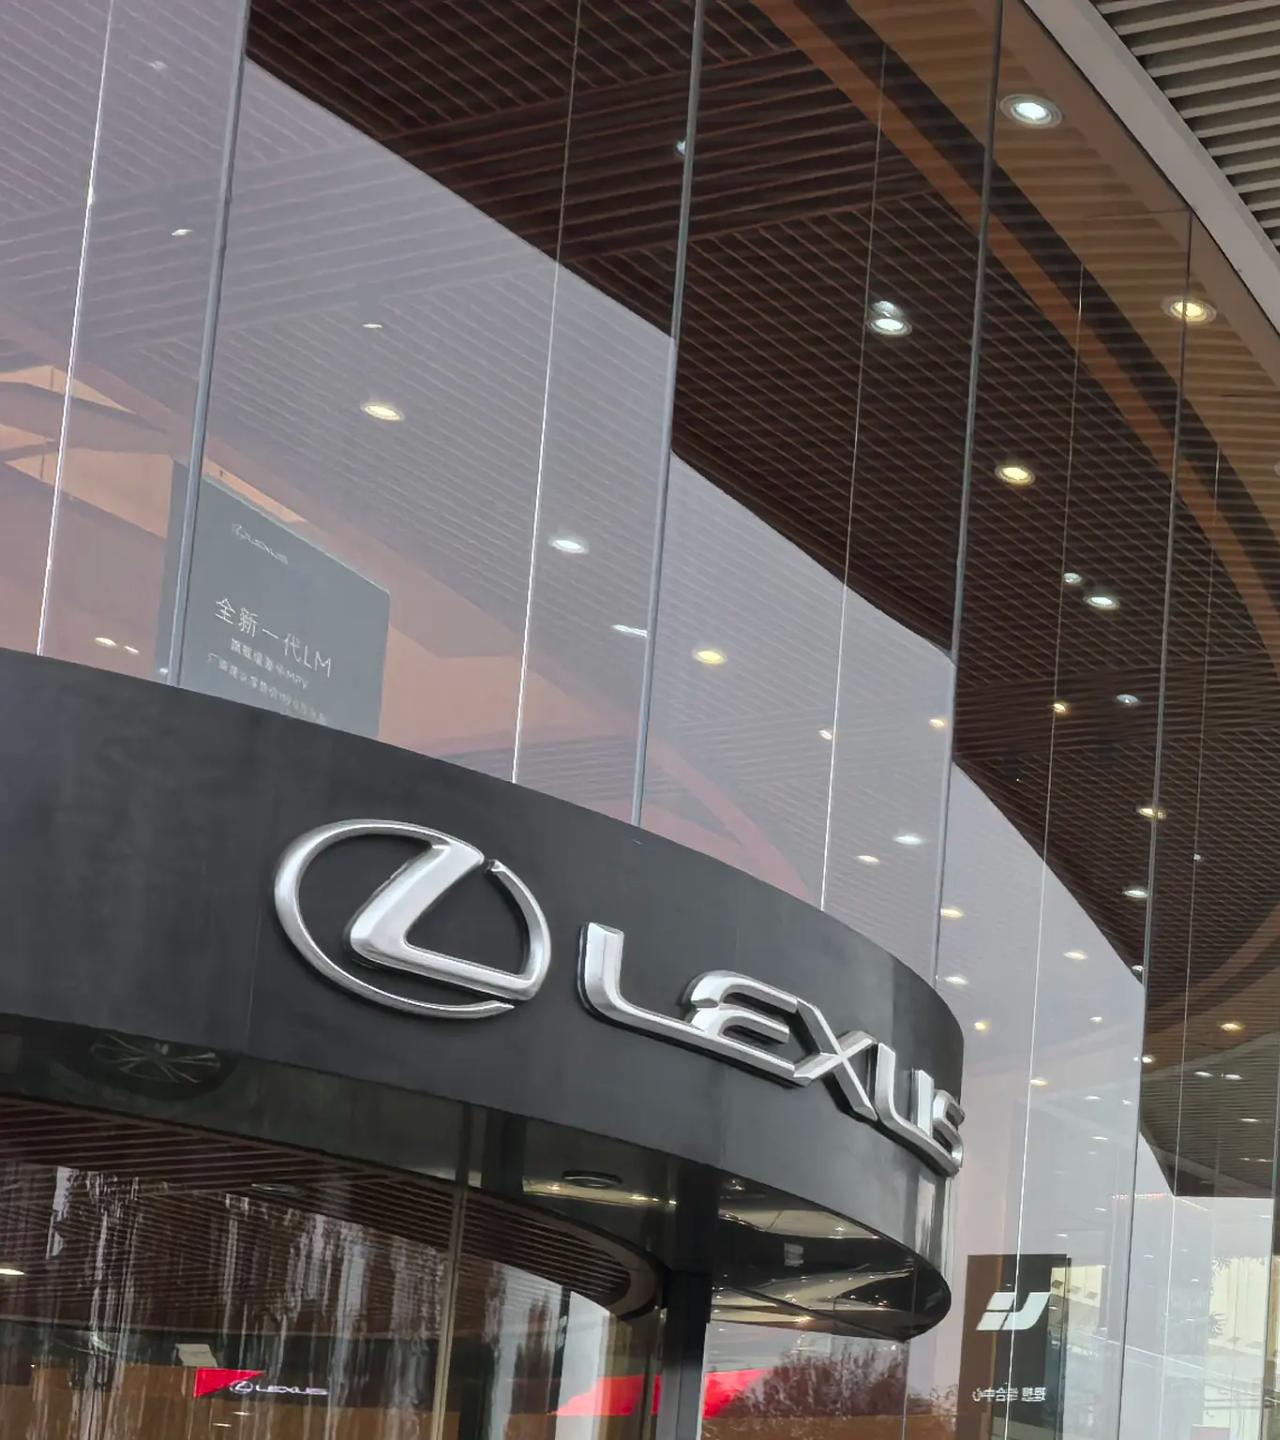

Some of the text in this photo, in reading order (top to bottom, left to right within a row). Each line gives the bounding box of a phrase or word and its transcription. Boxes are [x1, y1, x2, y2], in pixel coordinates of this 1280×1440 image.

[215, 598, 332, 678] 全新一代LM
[578, 922, 966, 1178] LEXUS
